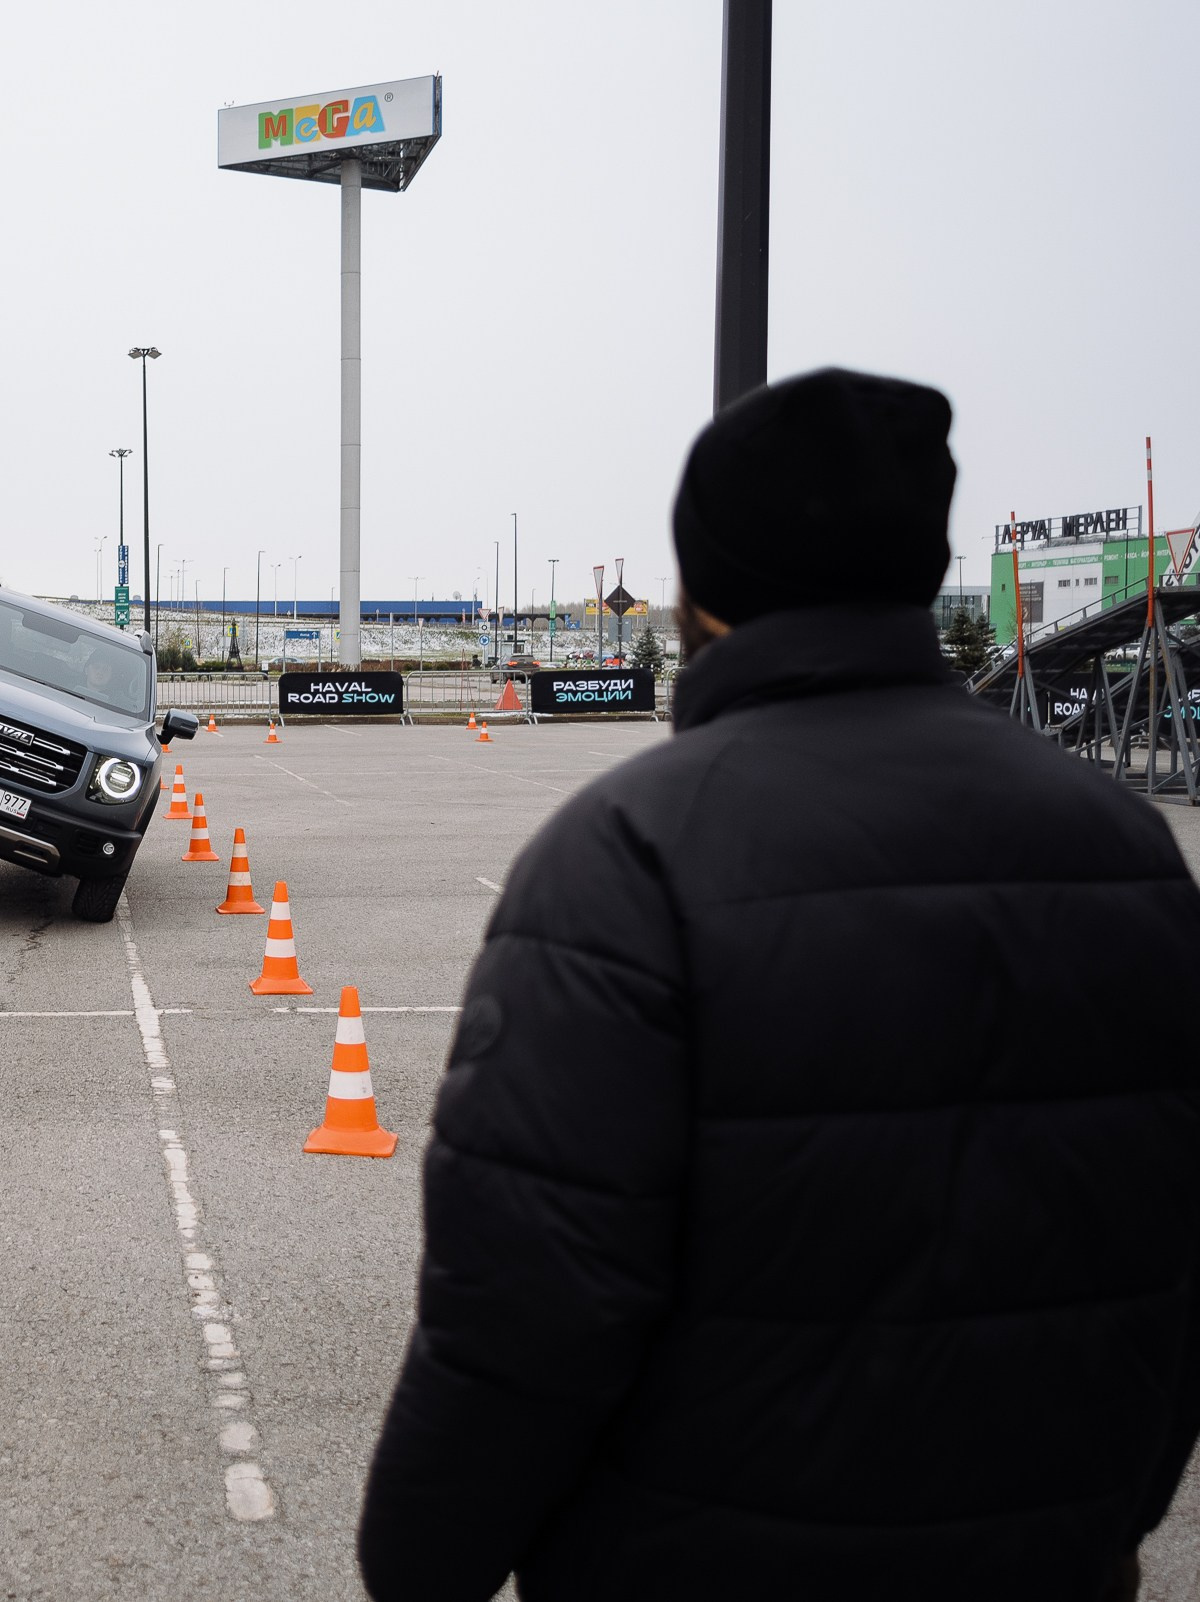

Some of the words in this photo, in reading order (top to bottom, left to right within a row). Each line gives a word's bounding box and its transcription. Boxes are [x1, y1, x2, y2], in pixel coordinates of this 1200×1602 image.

[1062, 508, 1127, 538] МЕРЛЕН
[310, 682, 372, 693] HAVAL
[553, 678, 634, 692] РАЗБУДИ
[287, 693, 338, 704] ROAD
[341, 692, 395, 703] SHOW
[555, 691, 631, 703] ЭМОЦИИ
[1054, 702, 1086, 716] ROA
